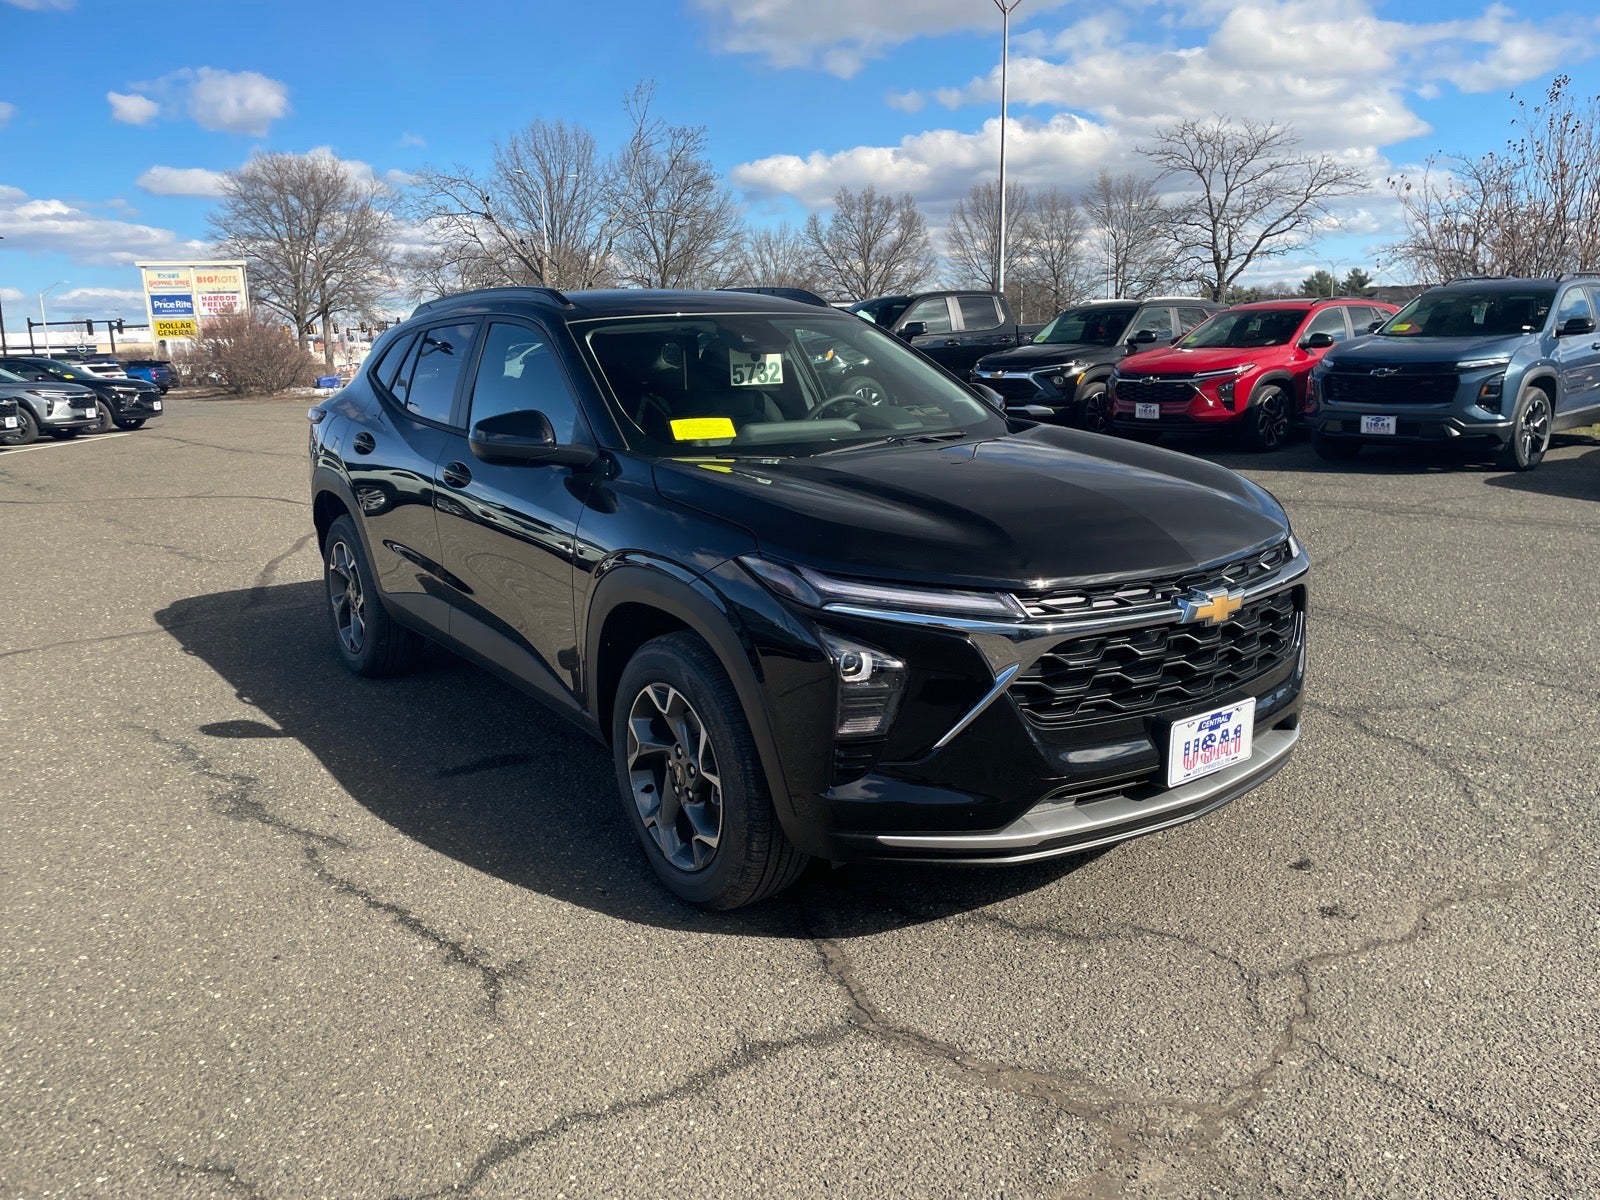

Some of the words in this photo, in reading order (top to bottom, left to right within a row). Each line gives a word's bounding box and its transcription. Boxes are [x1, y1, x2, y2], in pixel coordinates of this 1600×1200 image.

[154, 300, 175, 308] Price
[175, 300, 192, 308] Rite
[732, 362, 781, 385] 5732
[1201, 714, 1229, 729] CENTRAL
